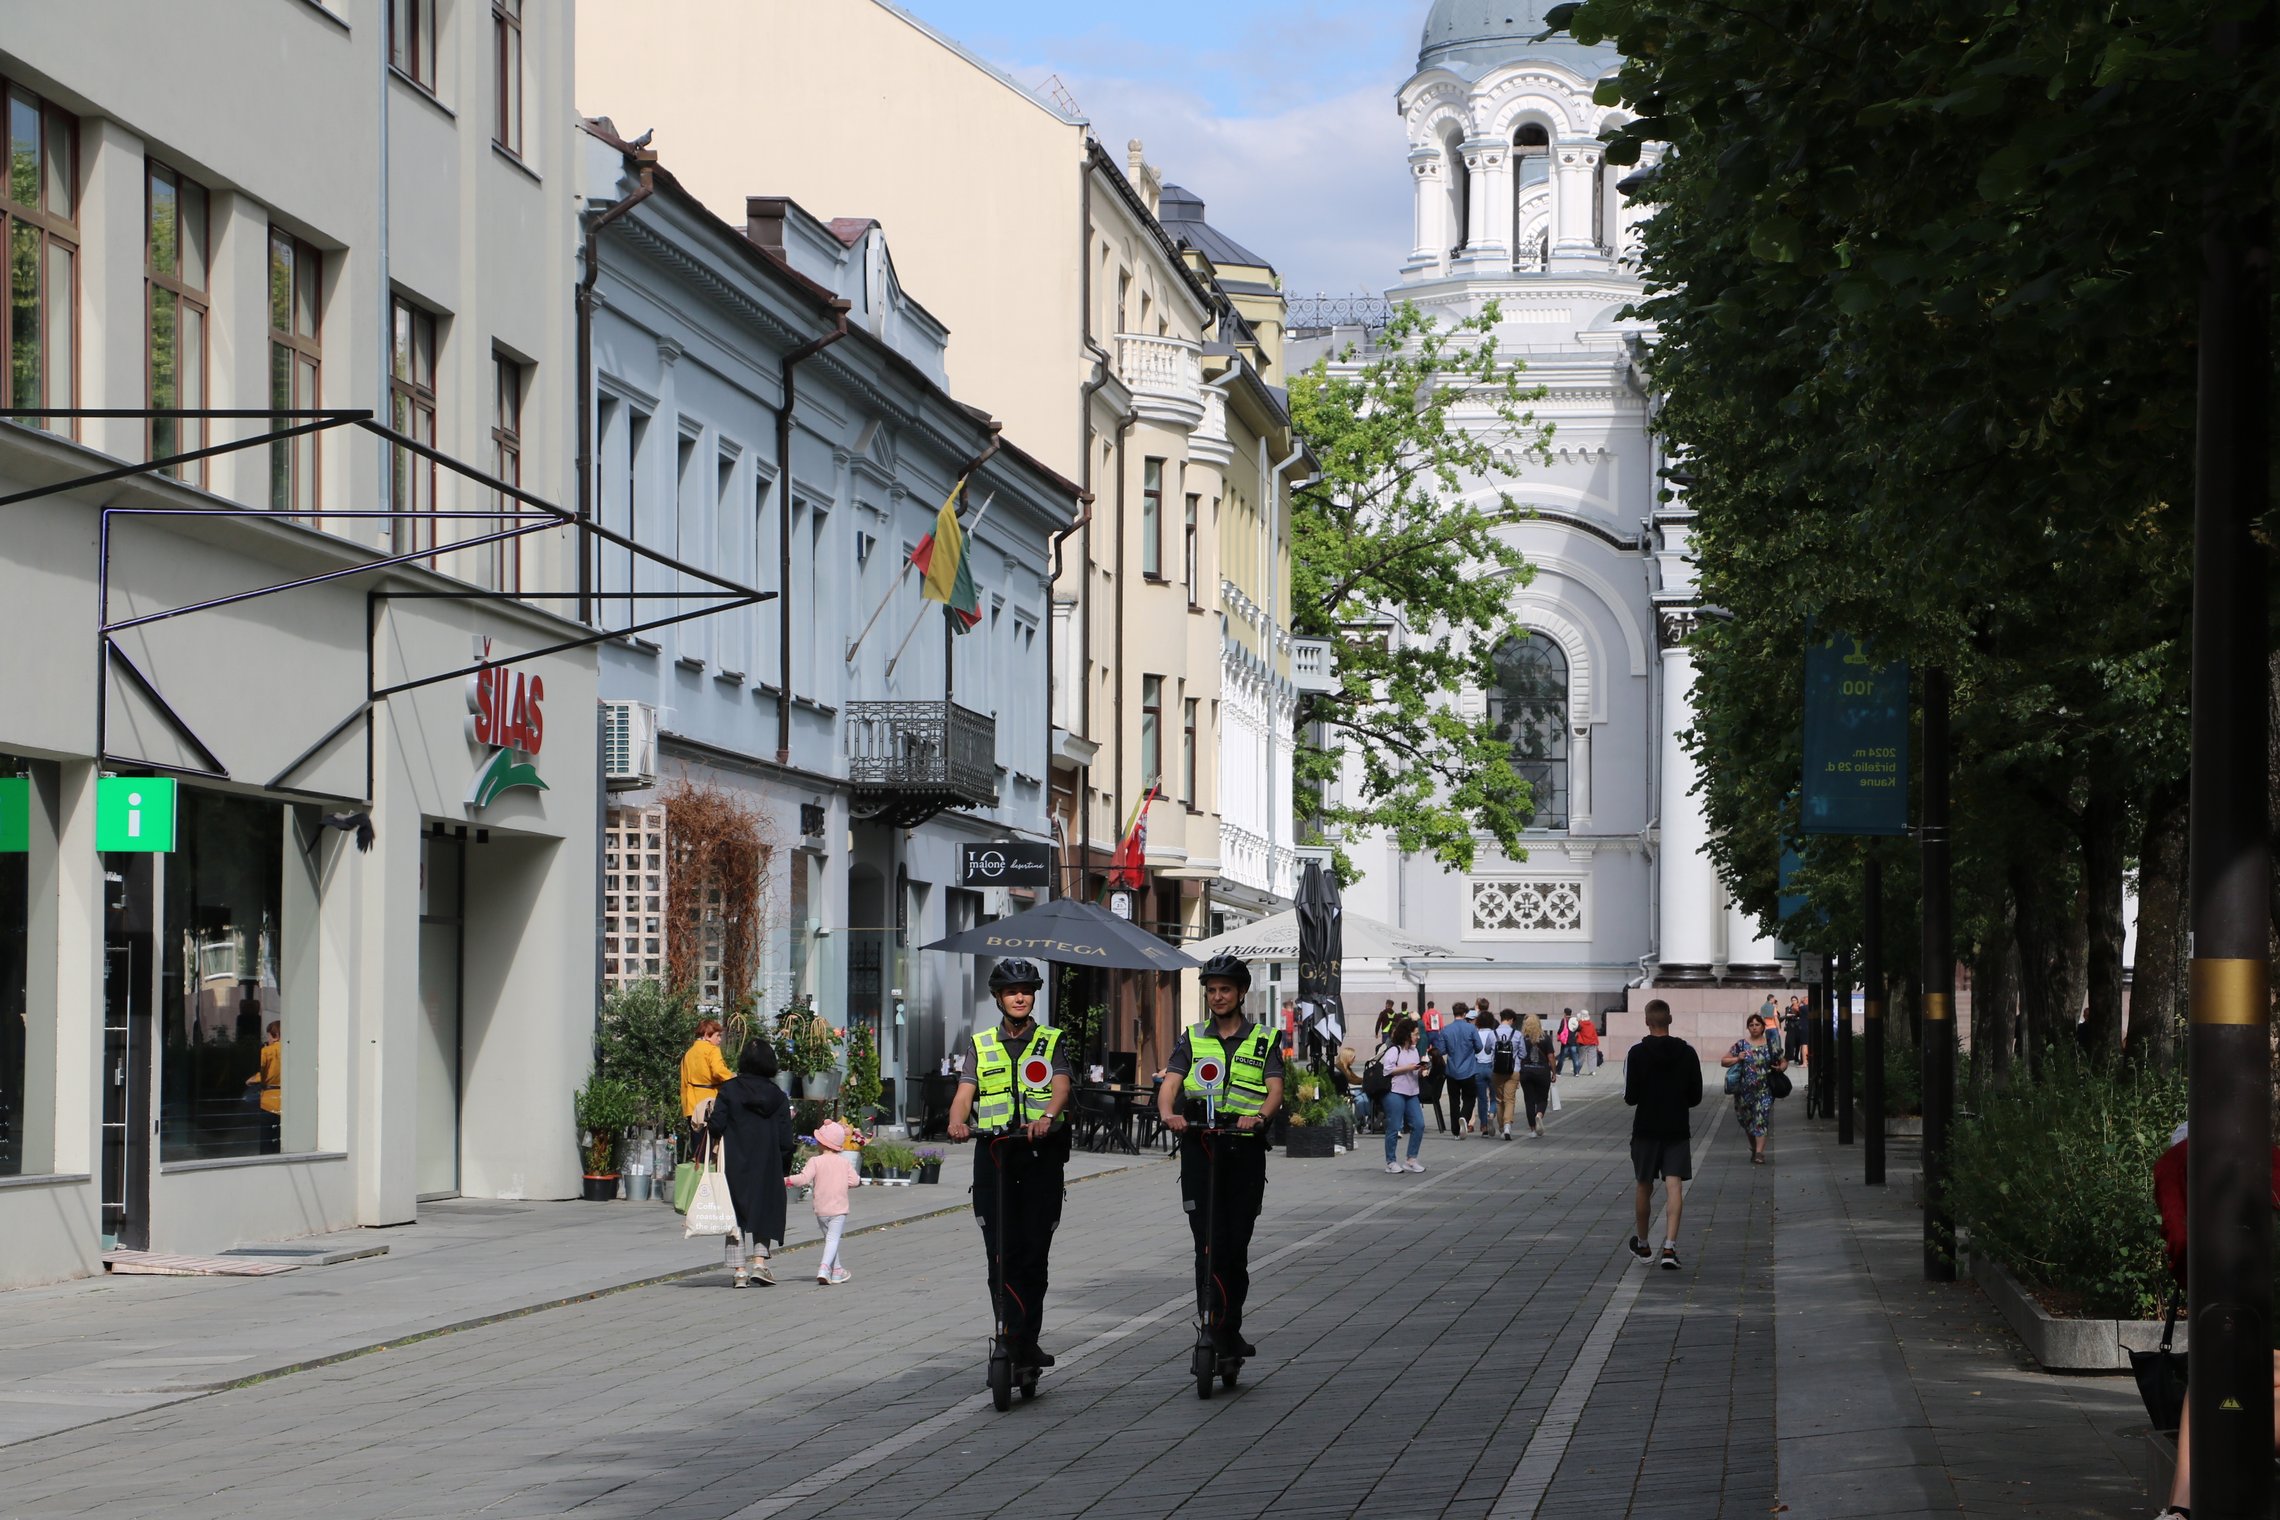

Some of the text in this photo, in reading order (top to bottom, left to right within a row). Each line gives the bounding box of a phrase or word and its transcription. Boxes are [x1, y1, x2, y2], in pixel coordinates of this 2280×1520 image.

[474, 635, 544, 756] ŠILAS
[986, 936, 1107, 956] BOTTEGA
[1235, 1056, 1262, 1067] POLICIJA
